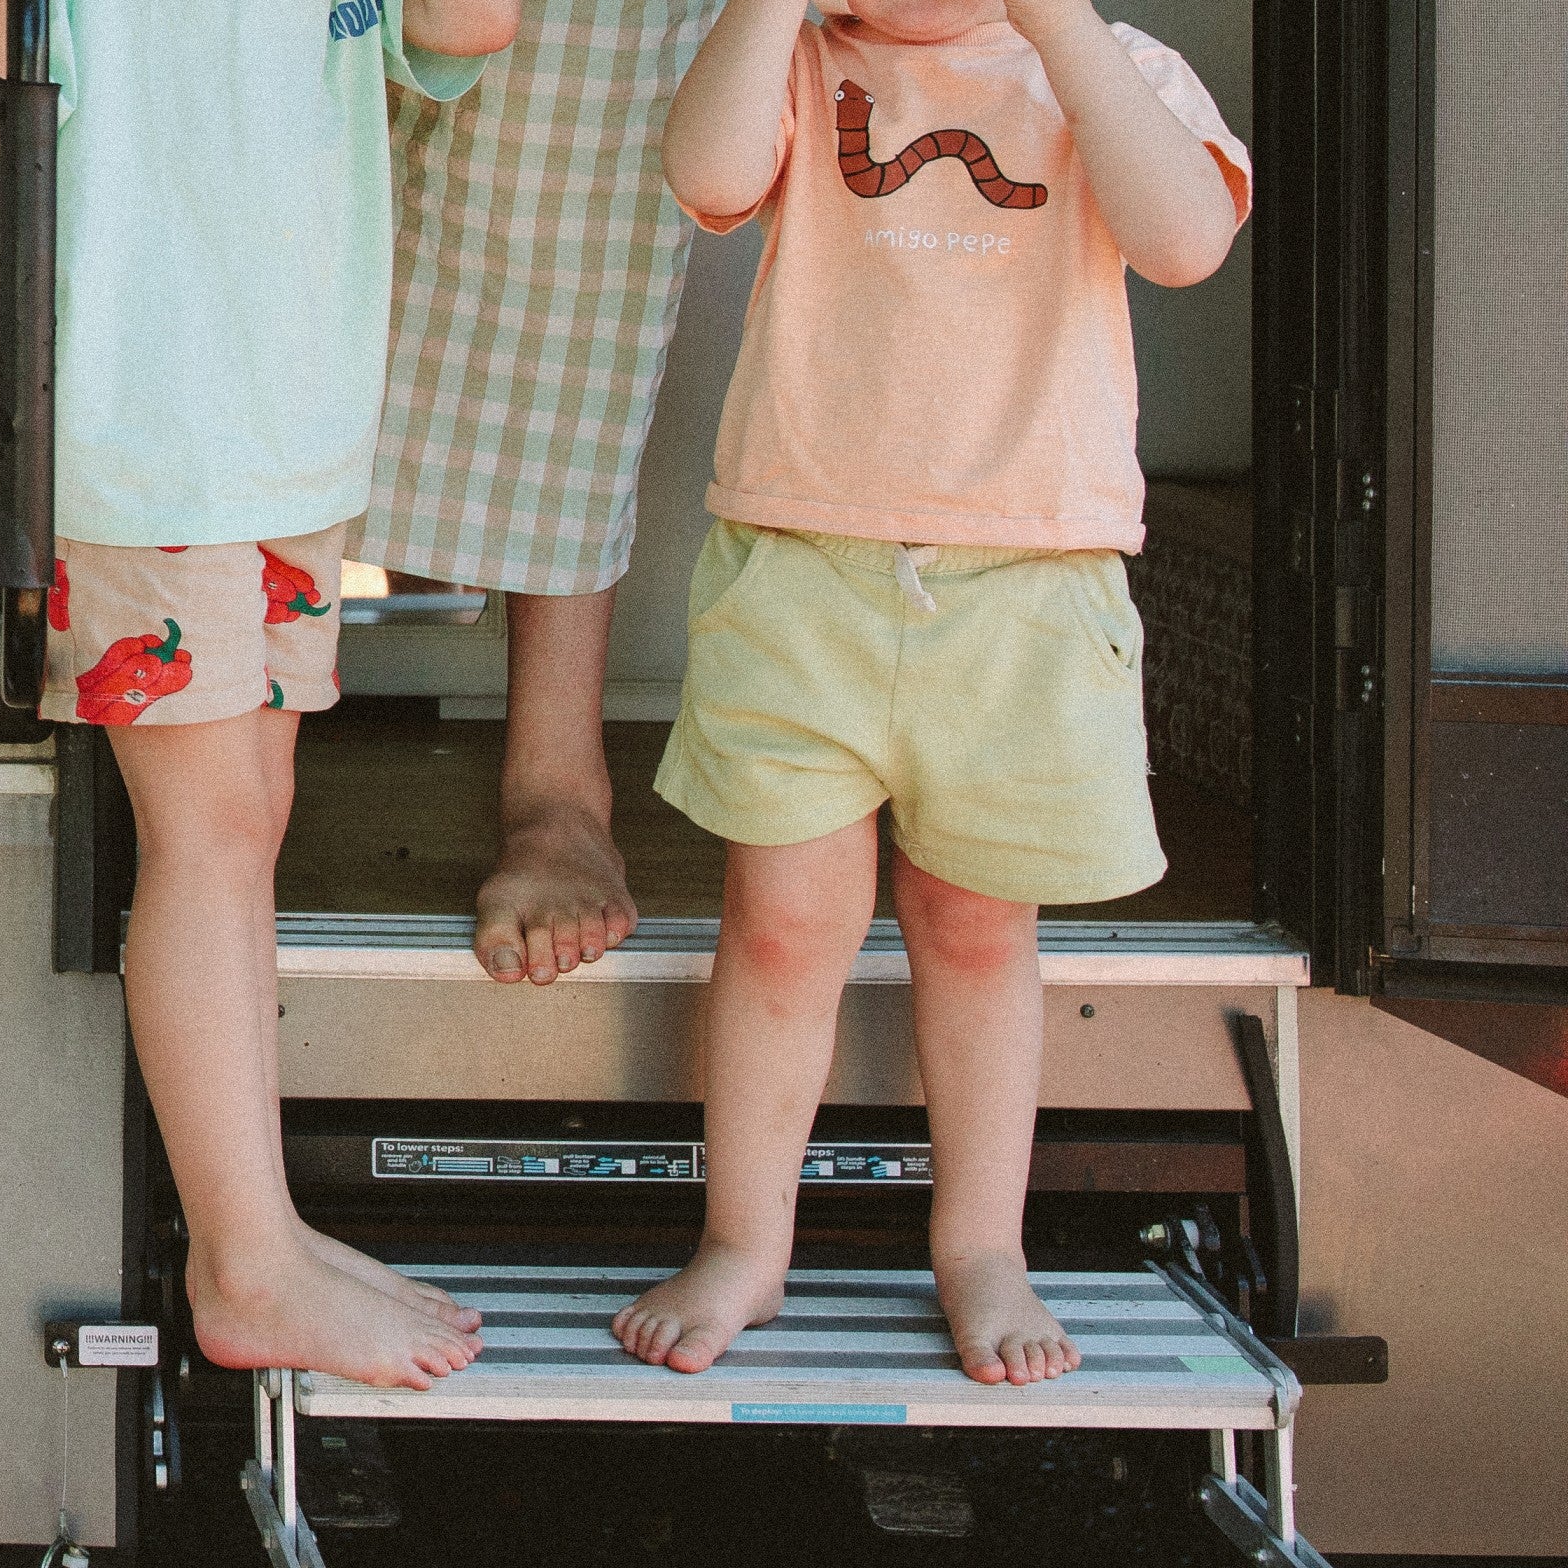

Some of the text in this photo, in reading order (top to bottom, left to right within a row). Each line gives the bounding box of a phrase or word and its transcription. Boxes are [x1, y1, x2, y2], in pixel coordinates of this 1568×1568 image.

[381, 1142, 464, 1154] To lower steps:
[804, 1148, 835, 1157] teps:
[85, 1334, 153, 1344] !!!WARNING!!!
